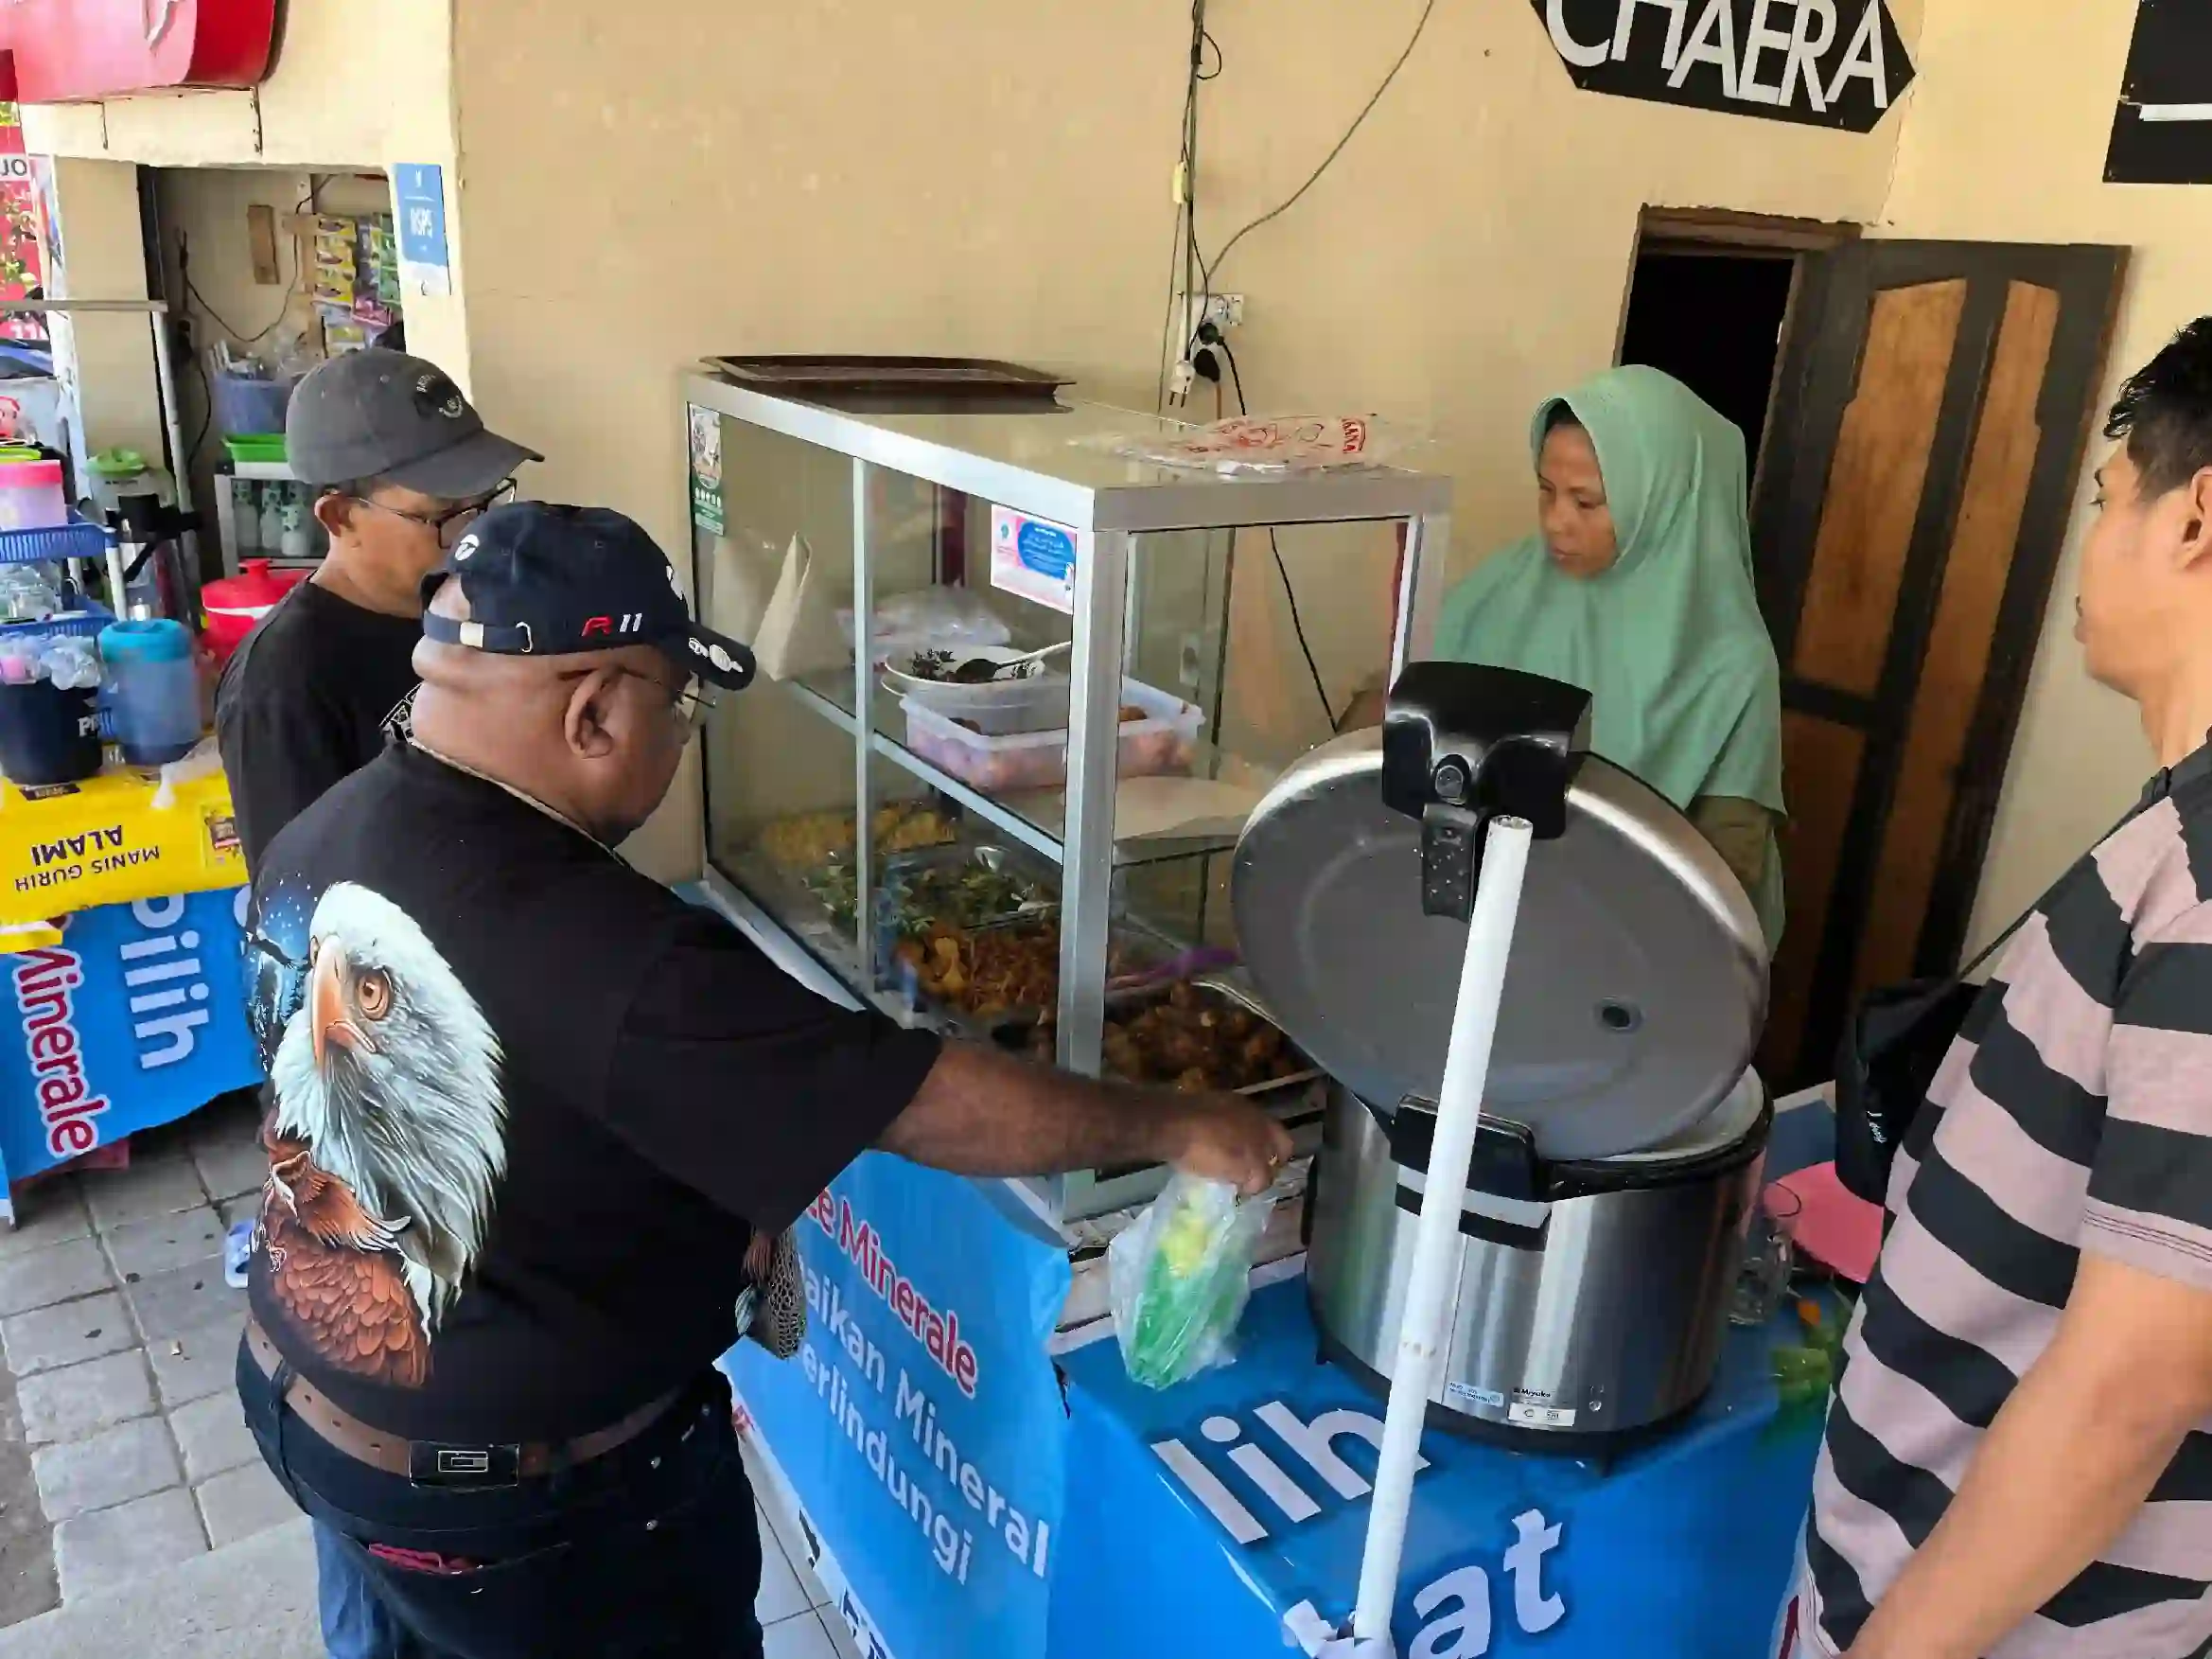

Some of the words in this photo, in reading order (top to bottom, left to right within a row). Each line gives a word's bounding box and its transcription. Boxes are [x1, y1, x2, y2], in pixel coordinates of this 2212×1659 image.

[31, 824, 124, 867] ALAMI
[91, 845, 160, 874] MANIS
[15, 865, 83, 892] GURIH
[807, 1188, 835, 1238] e
[839, 1197, 978, 1398] Minerale
[799, 1254, 886, 1393] aikan
[895, 1368, 1050, 1579] Mineral
